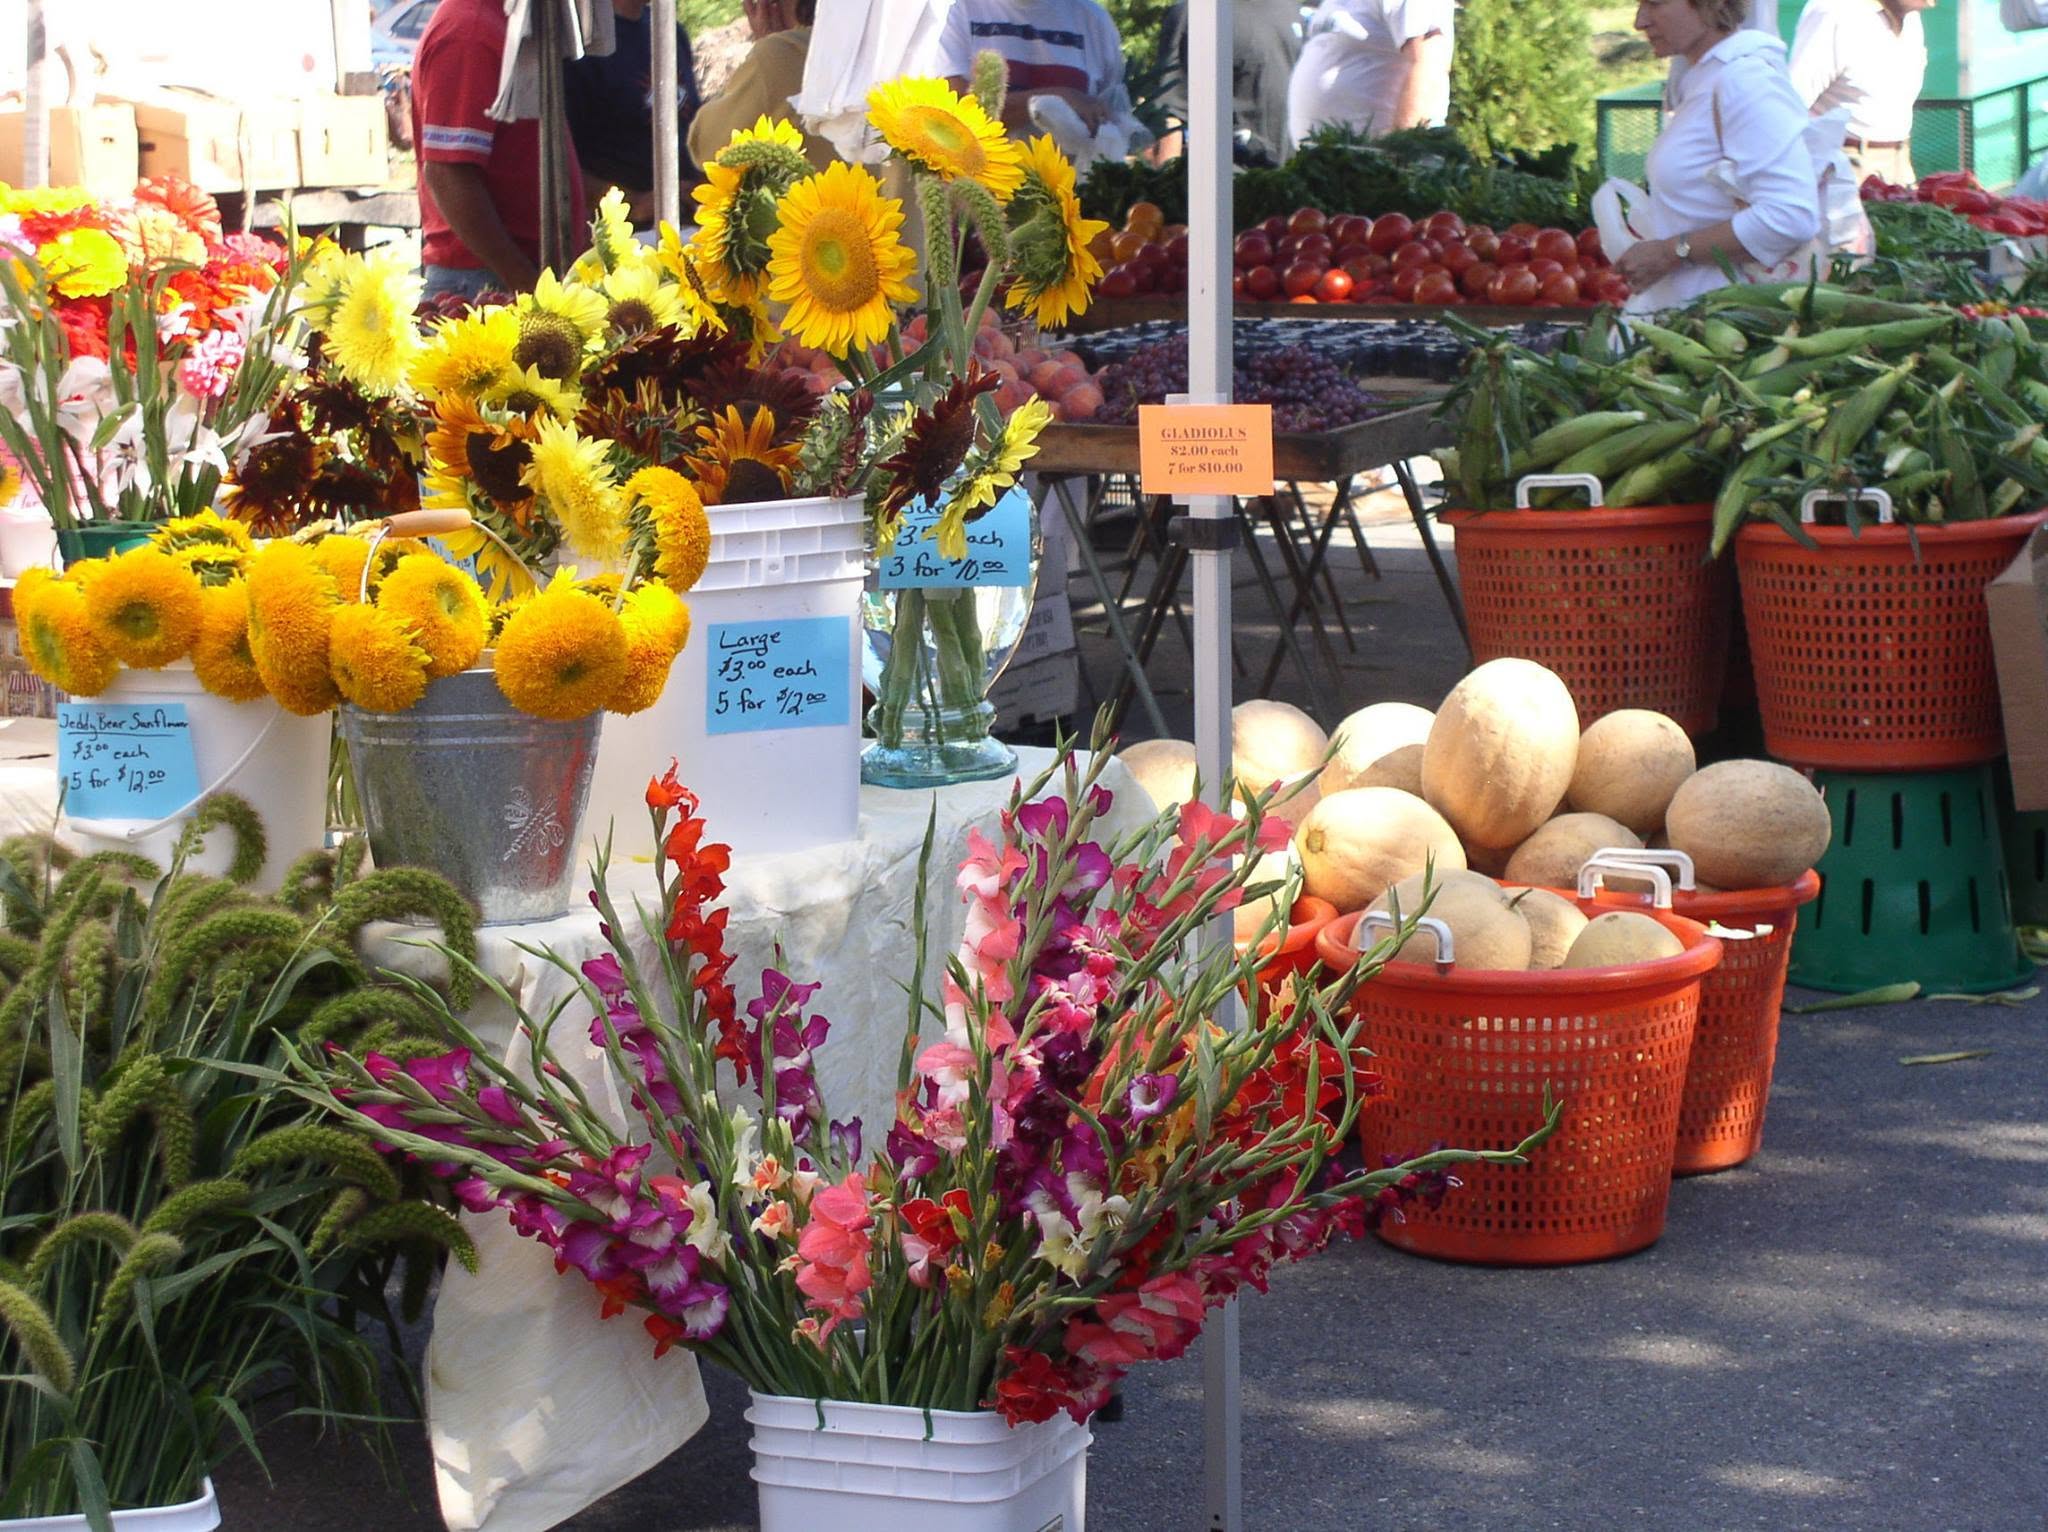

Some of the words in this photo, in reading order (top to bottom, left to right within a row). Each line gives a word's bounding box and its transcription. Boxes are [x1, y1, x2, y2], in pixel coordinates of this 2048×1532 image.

[1160, 428, 1247, 439] GLADIOLUS
[1170, 446, 1208, 456] $2.00
[1211, 445, 1238, 456] each
[1168, 463, 1175, 475] 7
[1178, 463, 1196, 473] for
[1198, 463, 1243, 473] $10.00
[966, 531, 1003, 547] ach
[888, 556, 905, 577] 3
[913, 552, 944, 577] for
[719, 630, 781, 657] Large
[717, 656, 766, 682] $3.00
[773, 659, 817, 678] each
[715, 690, 729, 715] 5
[737, 688, 766, 713] for
[776, 687, 827, 715] $12.00
[97, 713, 127, 731] Bear
[72, 741, 109, 760] $3.00
[113, 744, 150, 760] each
[70, 772, 82, 790] 5
[88, 768, 110, 789] for
[118, 763, 166, 793] $12.00
